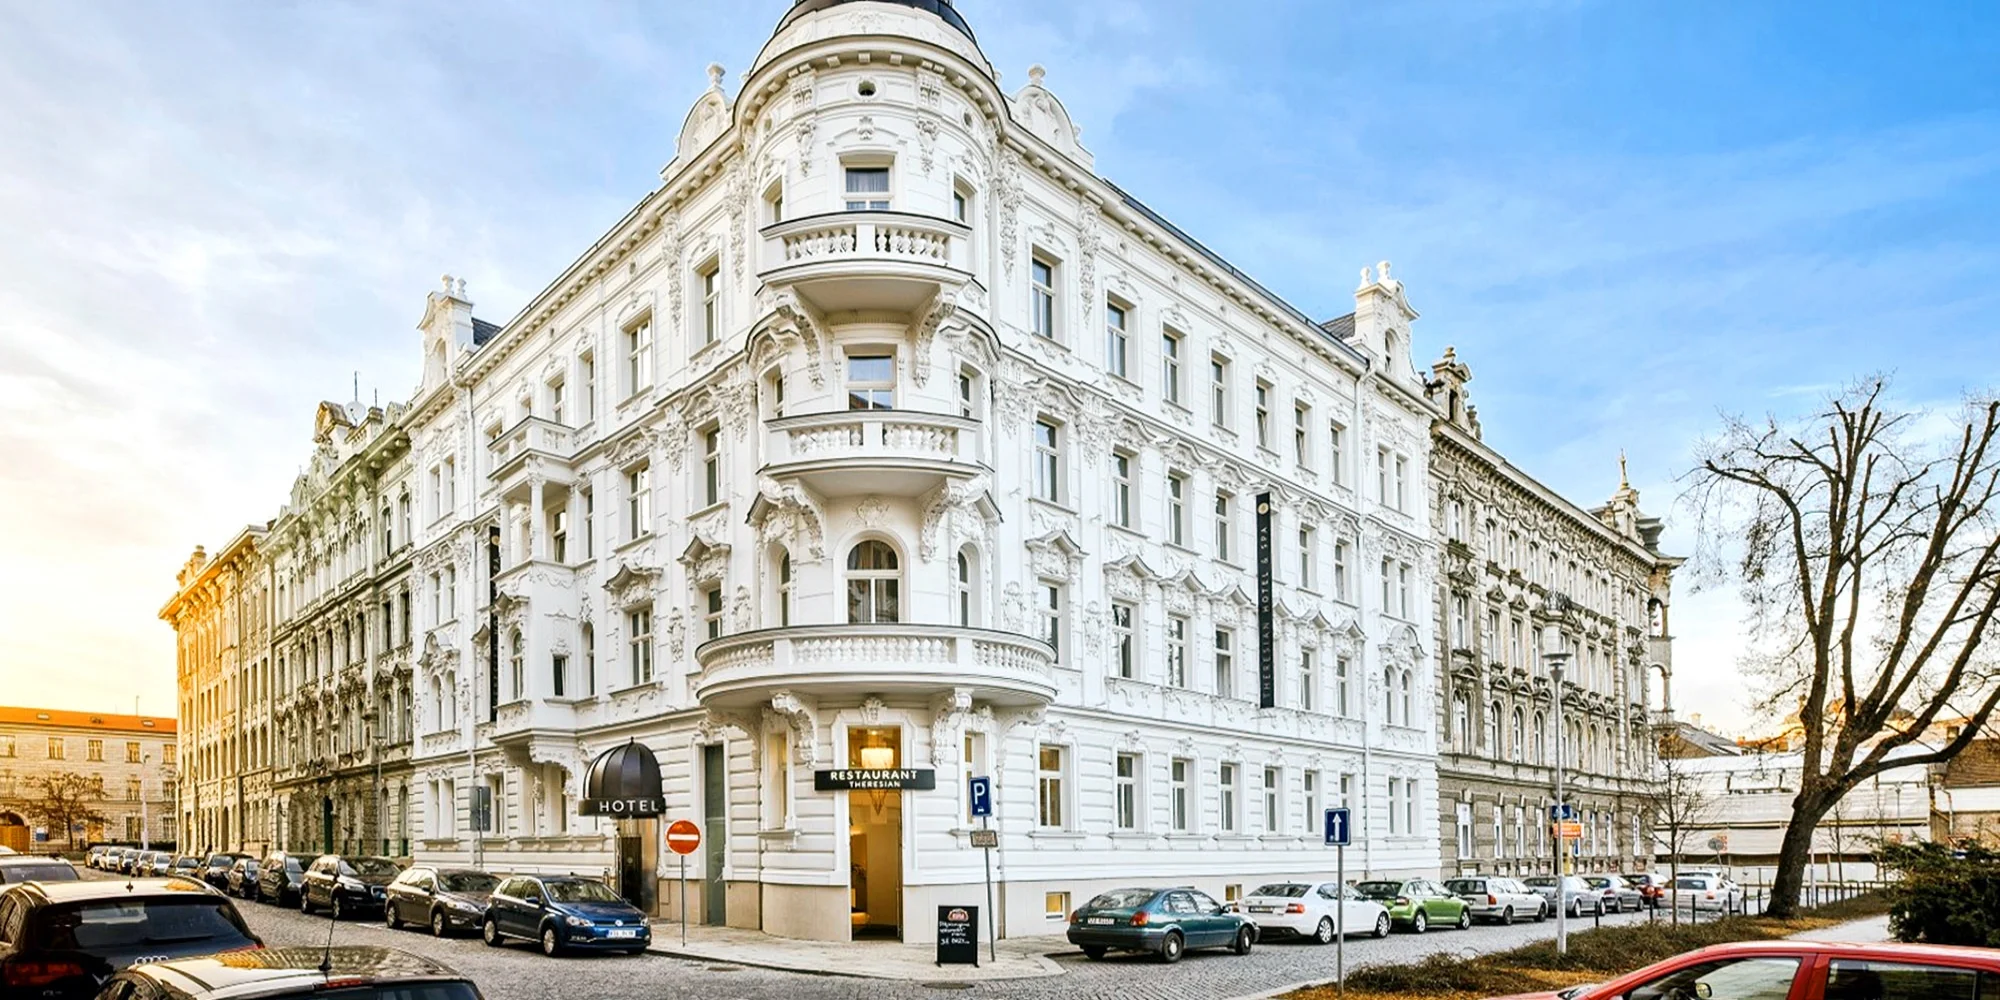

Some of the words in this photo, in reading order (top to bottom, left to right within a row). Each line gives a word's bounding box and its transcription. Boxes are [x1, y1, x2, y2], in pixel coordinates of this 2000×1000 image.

[1262, 572, 1270, 612] HOTEL
[1262, 622, 1271, 699] THERESIAN
[830, 770, 918, 780] RESTAURANT
[973, 782, 986, 805] P
[599, 800, 659, 812] HOTEL
